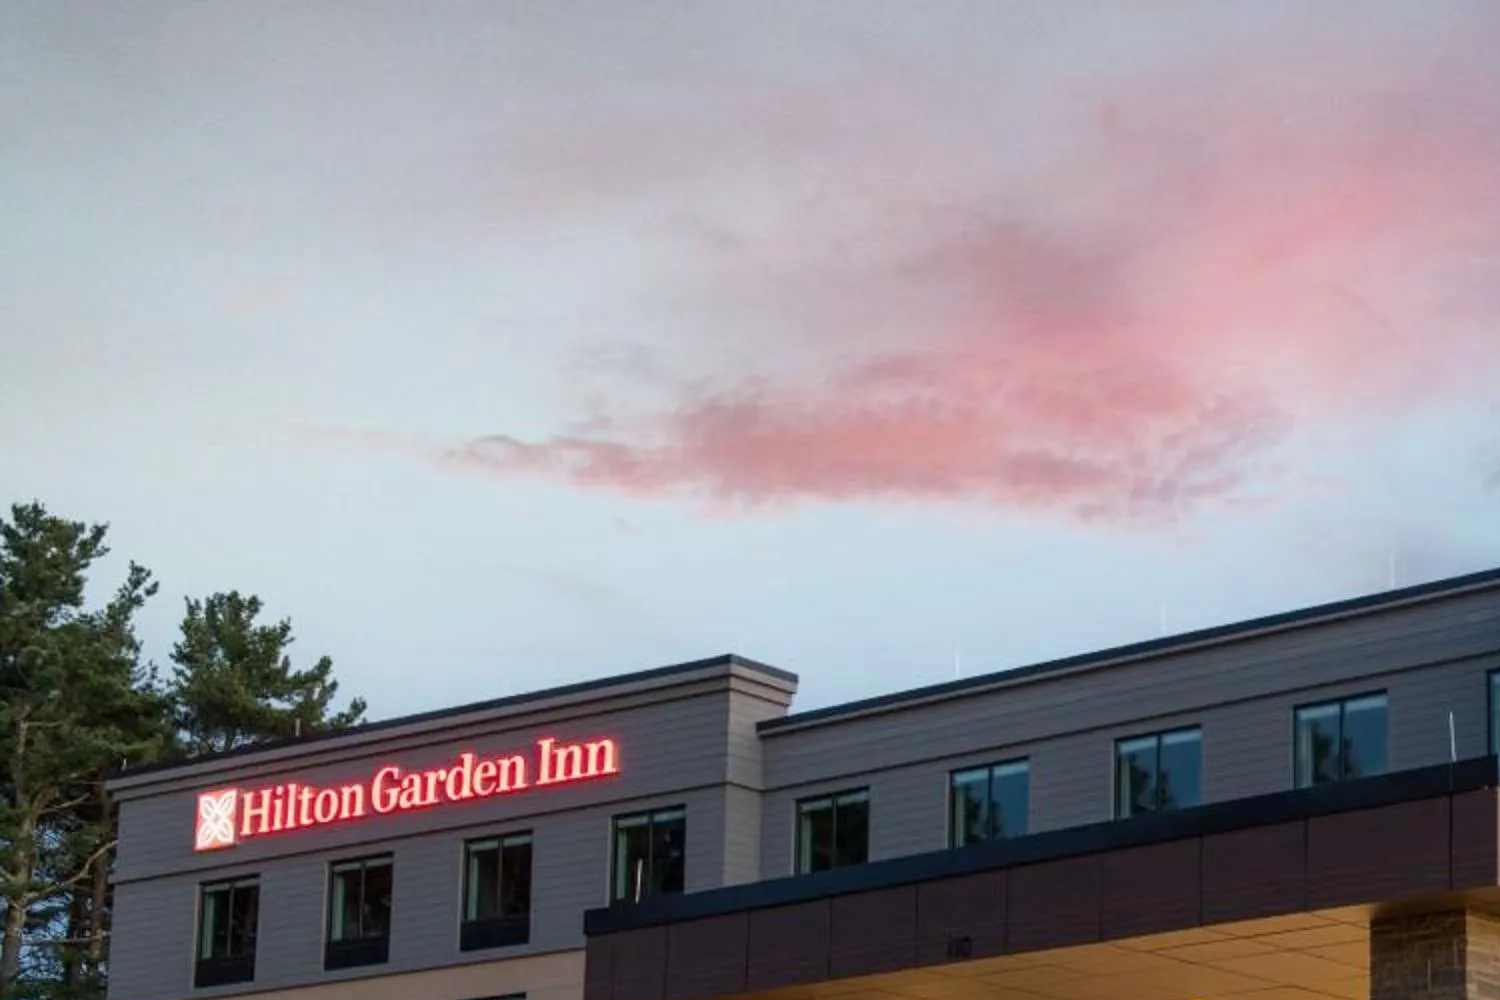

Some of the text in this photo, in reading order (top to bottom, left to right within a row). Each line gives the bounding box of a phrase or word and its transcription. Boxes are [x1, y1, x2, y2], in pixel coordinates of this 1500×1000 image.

[239, 736, 618, 836] Hilton Garden Inn
